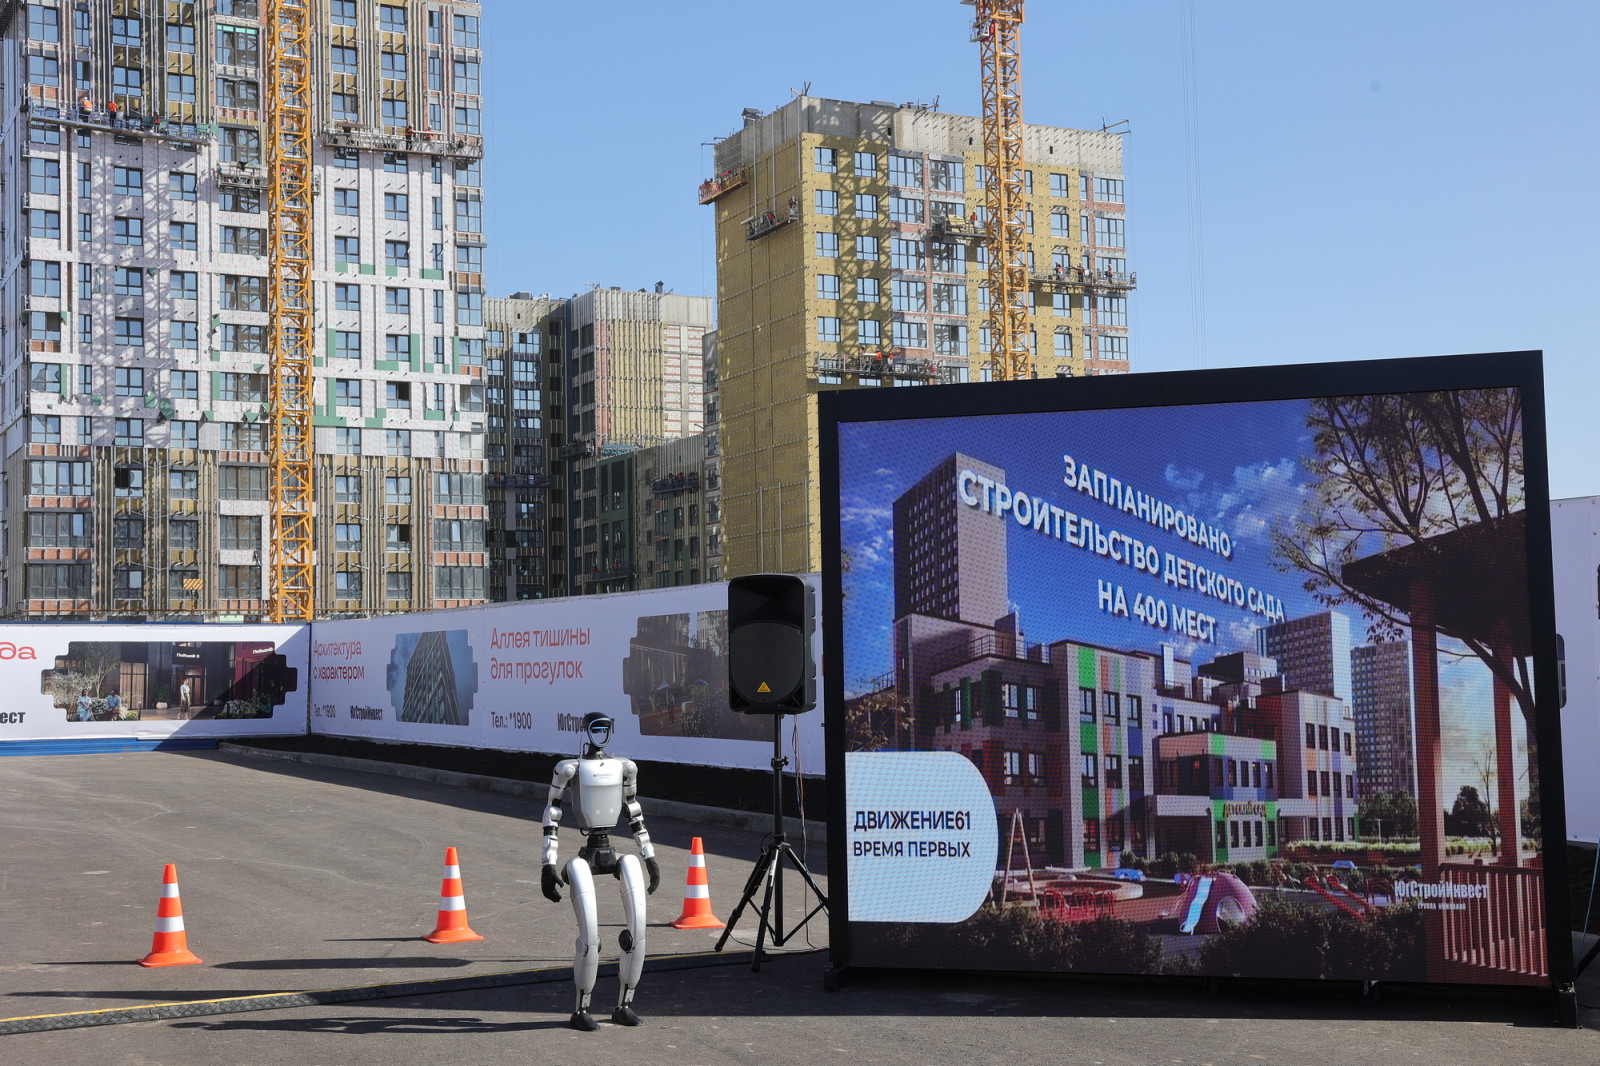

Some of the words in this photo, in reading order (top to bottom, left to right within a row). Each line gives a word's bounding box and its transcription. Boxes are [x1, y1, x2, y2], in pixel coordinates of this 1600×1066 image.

[1063, 455, 1232, 557] ЗАПЛАНИРОВАНО
[958, 469, 1160, 574] СТРОИТЕЛЬСТВО
[1163, 552, 1245, 606] ДЕТСКОГО
[1248, 586, 1286, 622] САДА
[1098, 579, 1129, 618] НА
[1133, 592, 1168, 628] 400
[1172, 604, 1217, 642] МЕСТ
[491, 627, 531, 650] Аллея
[533, 627, 590, 648] тишины
[313, 640, 362, 660] Архитектура
[318, 666, 365, 684] характером
[490, 657, 513, 680] для
[516, 660, 583, 685] прогулок
[491, 711, 508, 729] Тел.:
[853, 811, 971, 832] ДВИЖЕНИЕ61
[853, 841, 904, 857] ВРЕМЯ
[908, 841, 971, 857] ПЕРВЫХ
[1394, 879, 1488, 899] ЮгСтройИнвест
